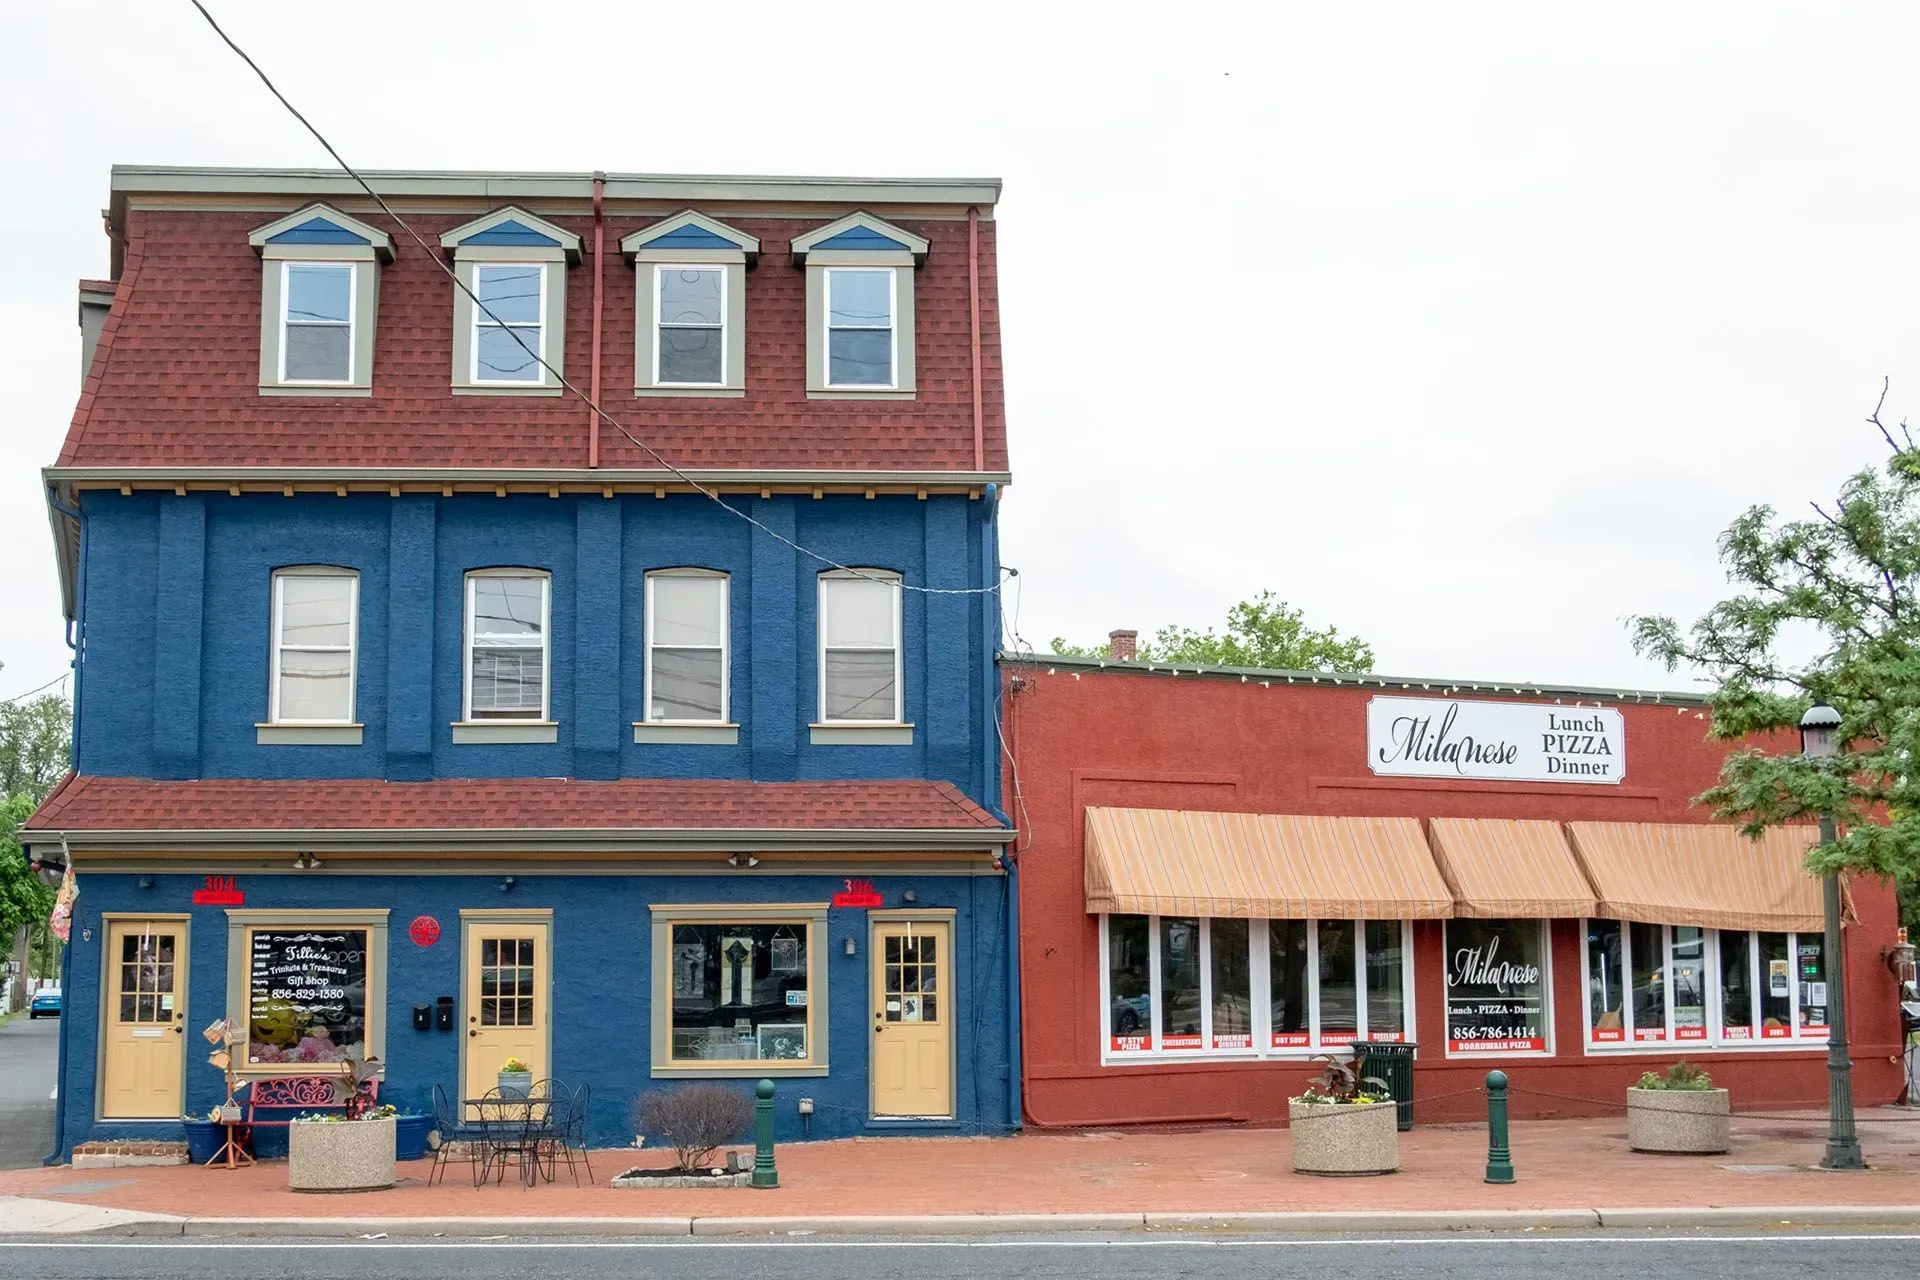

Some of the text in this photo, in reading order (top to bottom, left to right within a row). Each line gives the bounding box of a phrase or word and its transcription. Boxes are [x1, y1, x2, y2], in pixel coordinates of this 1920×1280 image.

[1548, 713, 1605, 732] Lunch
[1379, 703, 1518, 775] Milanese
[1542, 734, 1613, 756] PIZZA
[1546, 757, 1610, 775] Dinner
[204, 874, 236, 892] 304
[285, 946, 331, 961] Tillie's
[269, 963, 300, 975] Trinkets
[302, 963, 308, 971] &
[310, 963, 348, 975] Treasures
[1447, 935, 1539, 993] Milanese
[287, 975, 329, 987] Gift Shop
[271, 988, 345, 999] 856-829-1380
[1448, 1005, 1540, 1014] Lunch PIZZA Dinner
[1213, 1034, 1250, 1042] HOMEMADE
[1453, 1026, 1536, 1039] 856-786-1414
[1289, 1036, 1307, 1044] SOUP
[1458, 1041, 1531, 1051] BOARDWALK PIZZA
